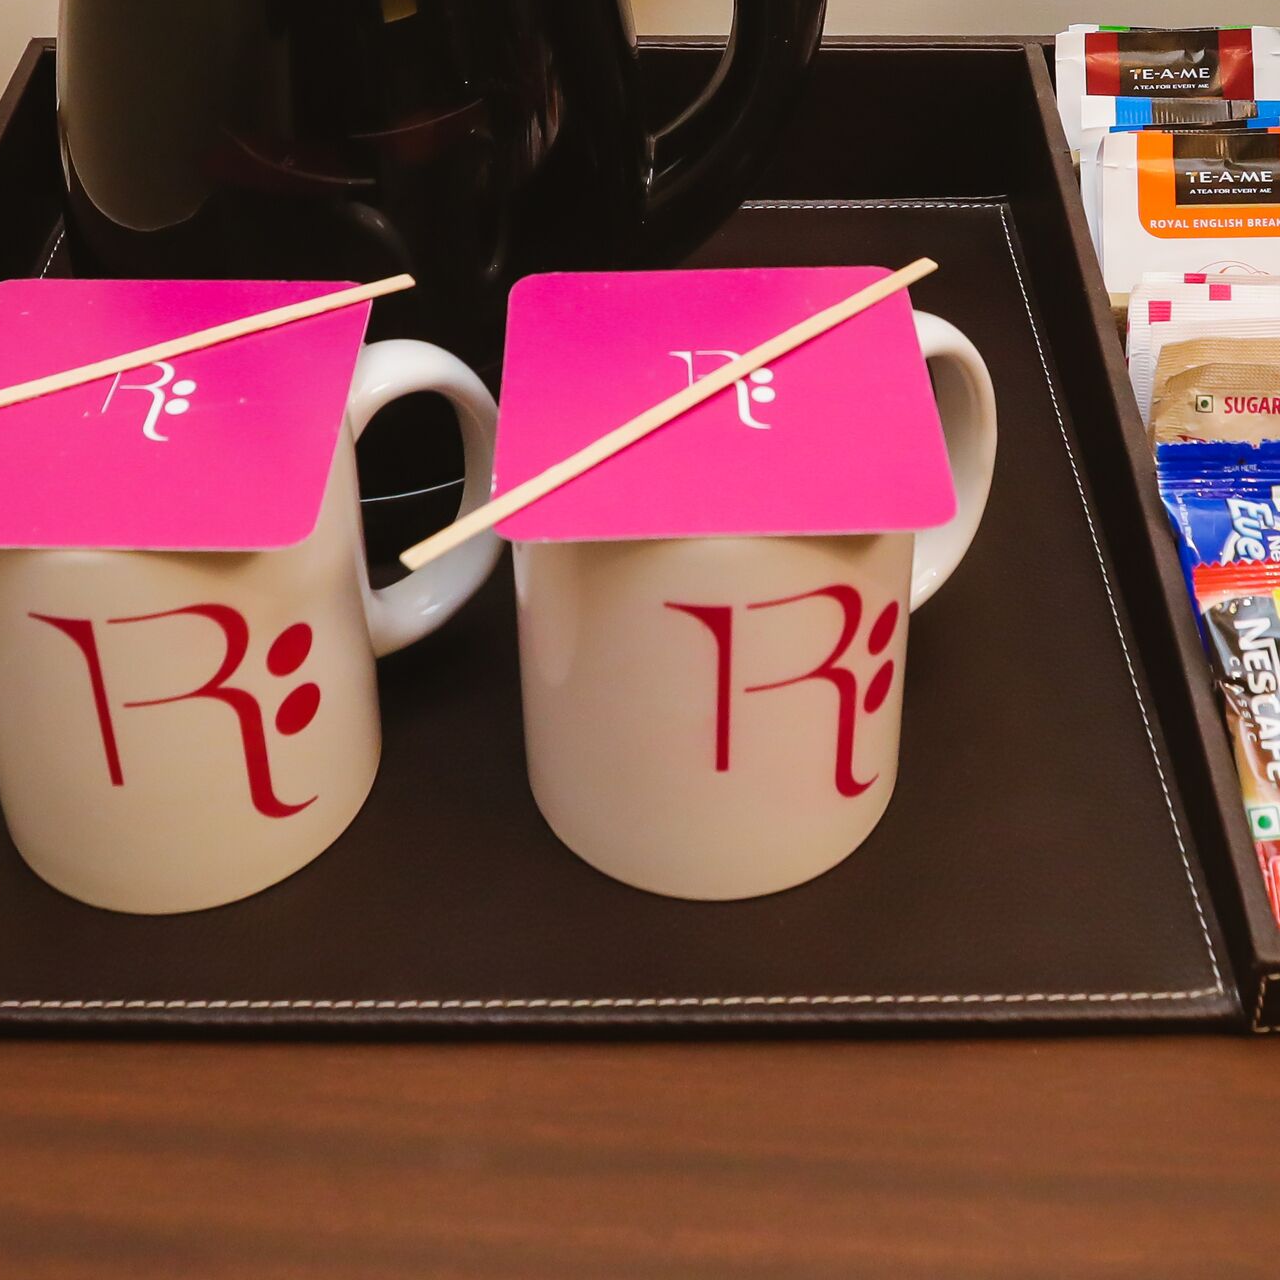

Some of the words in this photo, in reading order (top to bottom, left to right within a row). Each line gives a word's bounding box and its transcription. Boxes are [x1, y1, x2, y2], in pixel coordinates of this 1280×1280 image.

[1129, 67, 1210, 80] TE-A-ME
[1185, 171, 1273, 183] TE-A-ME
[1150, 219, 1189, 229] ROYAL
[1193, 218, 1243, 228] ENGLISH
[1227, 656, 1257, 743] CLASSIC
